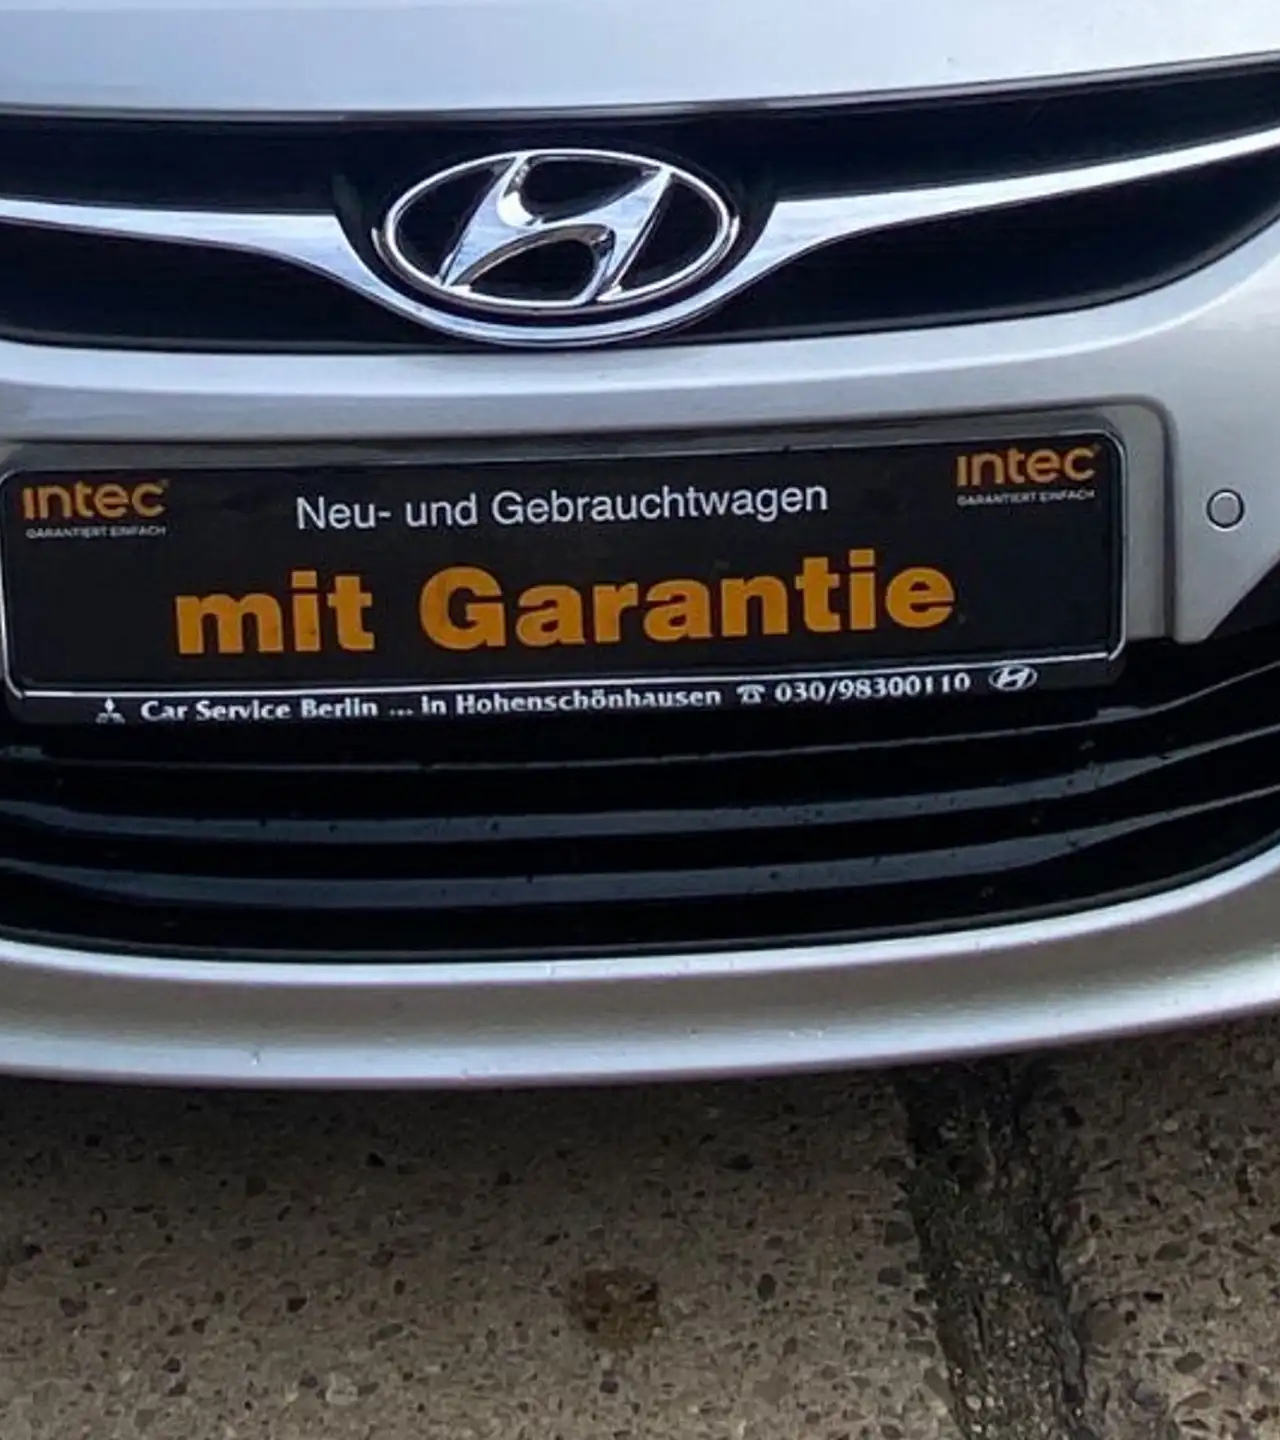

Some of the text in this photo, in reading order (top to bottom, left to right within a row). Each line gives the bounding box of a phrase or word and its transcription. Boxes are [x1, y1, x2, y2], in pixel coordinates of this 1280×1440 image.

[956, 446, 1097, 487] intec
[23, 480, 167, 520] intec
[295, 484, 829, 530] Neu- und Gebrauchtwagen
[175, 548, 955, 655] mit Garantie
[140, 699, 189, 721] Car
[195, 698, 292, 721] Service
[300, 696, 379, 720] Berlin
[455, 686, 722, 715] Hohenschönhausen
[774, 671, 971, 705] 030/98300110
